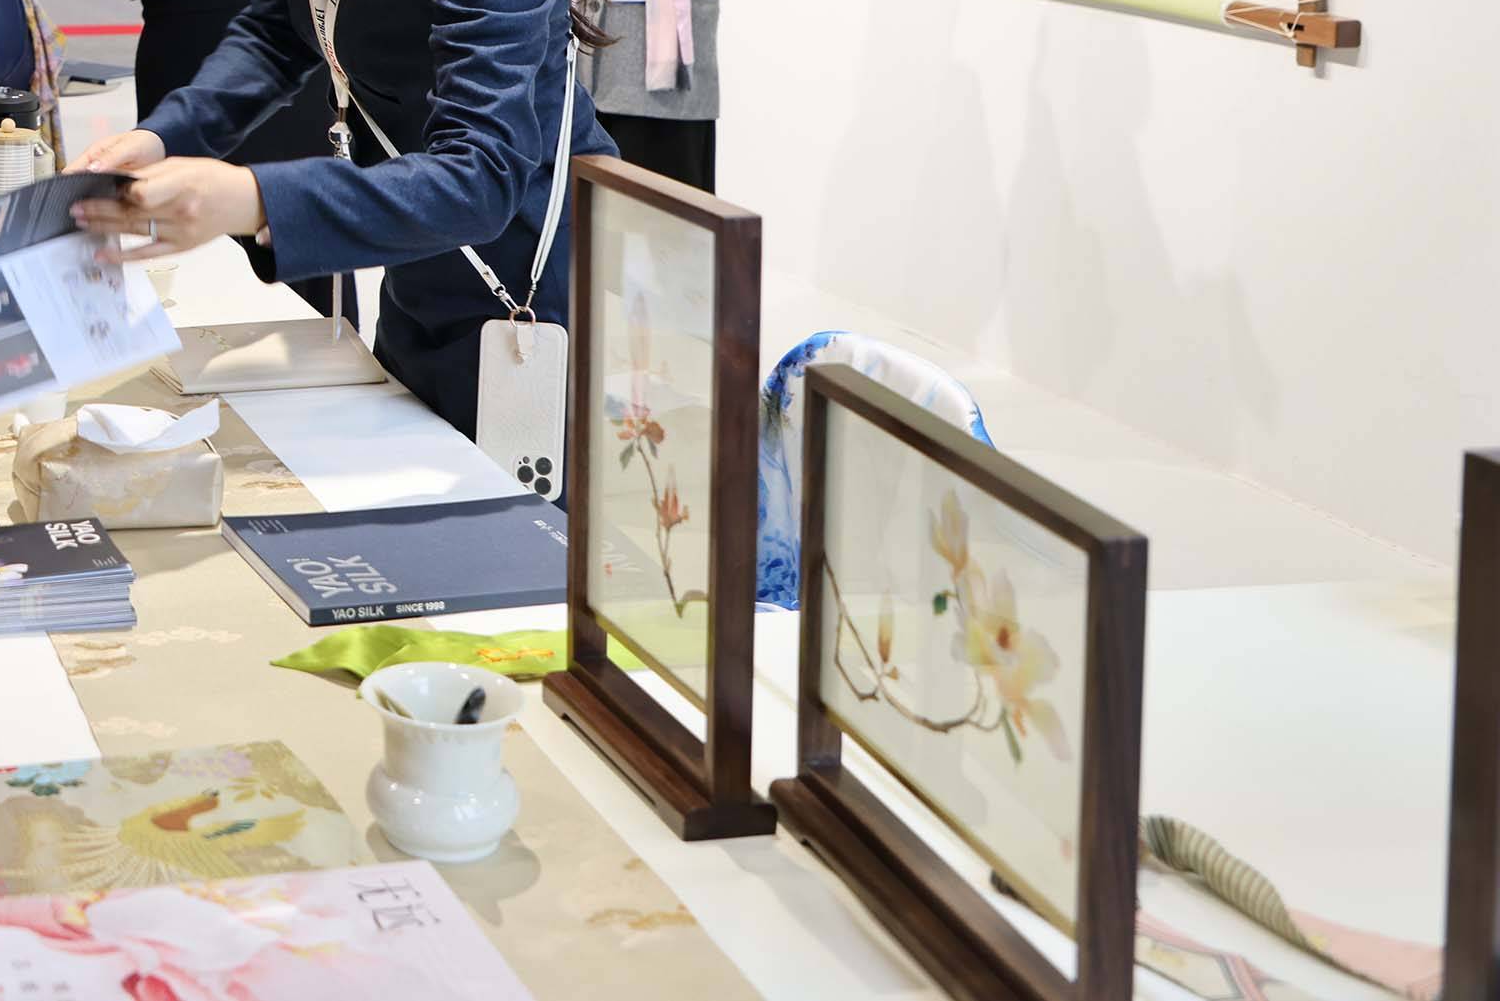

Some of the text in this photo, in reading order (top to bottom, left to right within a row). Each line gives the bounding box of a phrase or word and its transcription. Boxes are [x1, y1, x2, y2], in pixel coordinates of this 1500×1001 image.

[44, 522, 79, 551] SILK
[70, 519, 101, 545] YAO
[327, 554, 398, 595] SILK
[332, 607, 356, 620] YAO
[357, 605, 385, 618] SILK
[396, 602, 424, 613] SINCE
